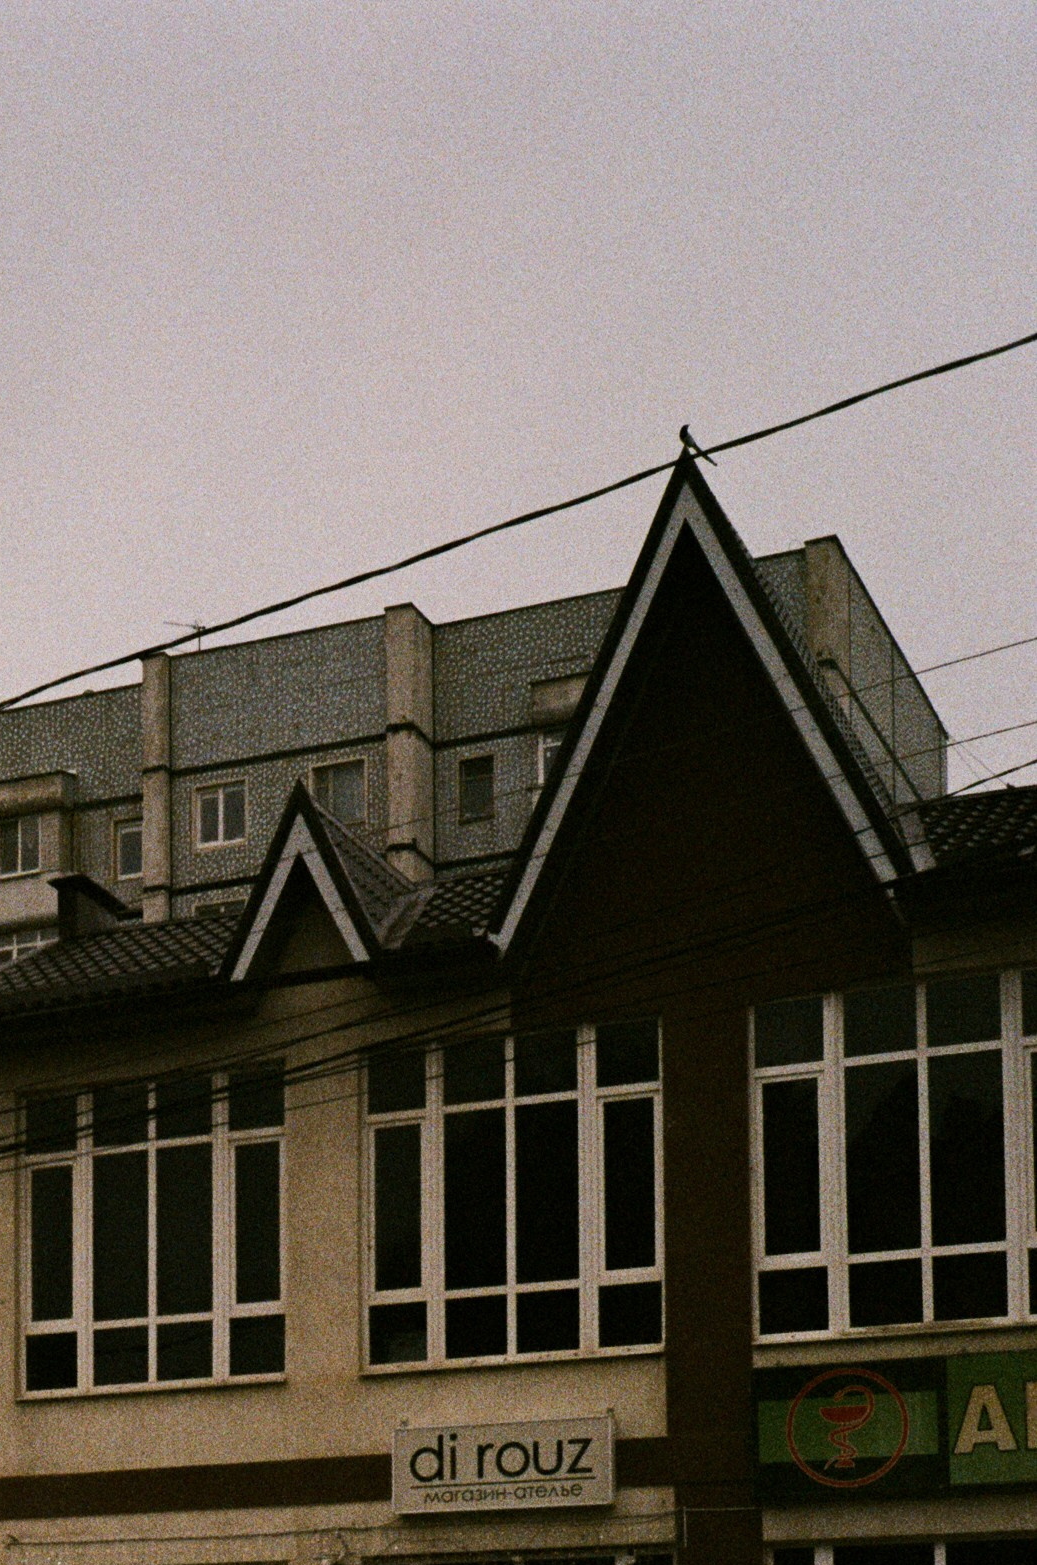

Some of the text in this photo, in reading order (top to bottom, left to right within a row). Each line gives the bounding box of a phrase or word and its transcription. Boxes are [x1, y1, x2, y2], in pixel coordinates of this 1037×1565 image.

[410, 1433, 592, 1482] di rouz
[423, 1483, 583, 1504] магазин-ателье
